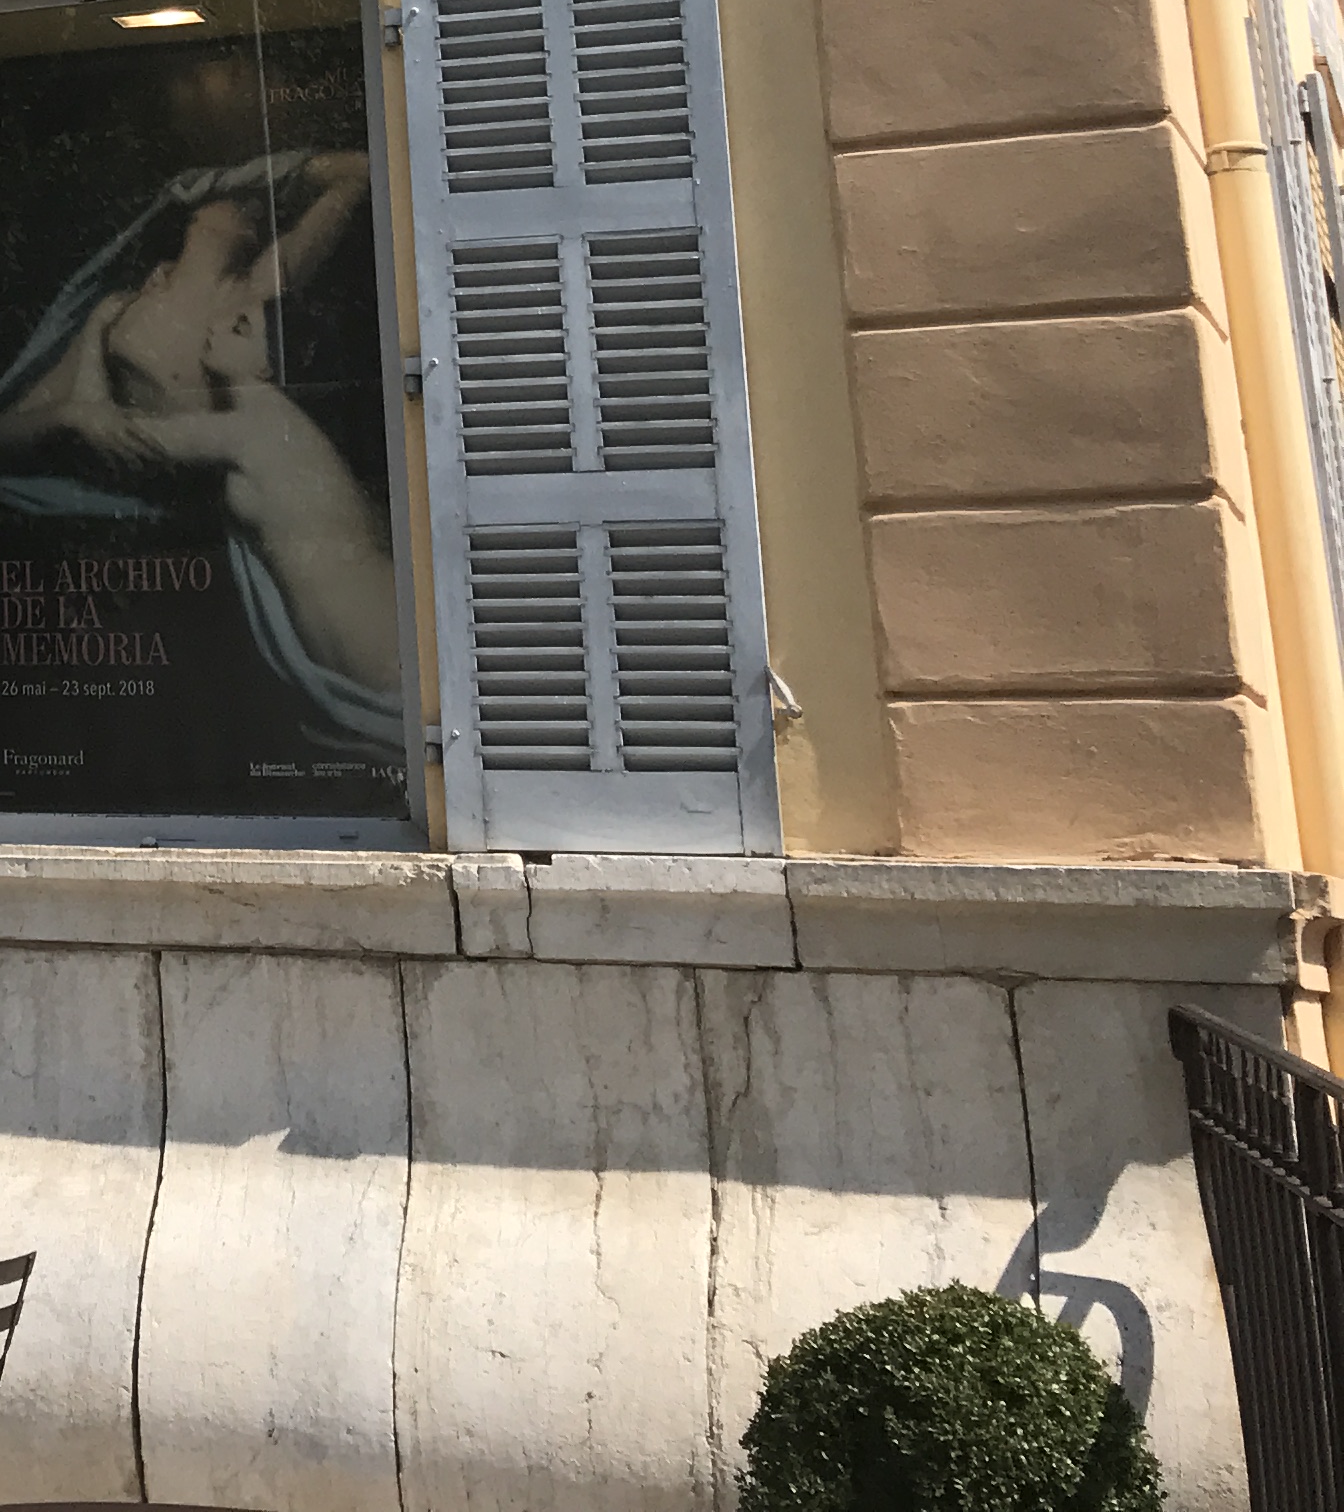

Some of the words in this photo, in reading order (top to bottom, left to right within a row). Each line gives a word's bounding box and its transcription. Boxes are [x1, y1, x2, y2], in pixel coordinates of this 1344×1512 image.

[0, 560, 44, 594] EL
[54, 556, 213, 593] ARCHIVO
[0, 595, 46, 630] DE
[55, 594, 103, 630] LA
[0, 631, 170, 667] MEMORIA
[1, 680, 18, 696] 26
[21, 680, 46, 696] mai
[62, 680, 80, 696] 23
[82, 680, 116, 700] sept.
[118, 680, 156, 697] 2018
[2, 748, 84, 770] Fragonard
